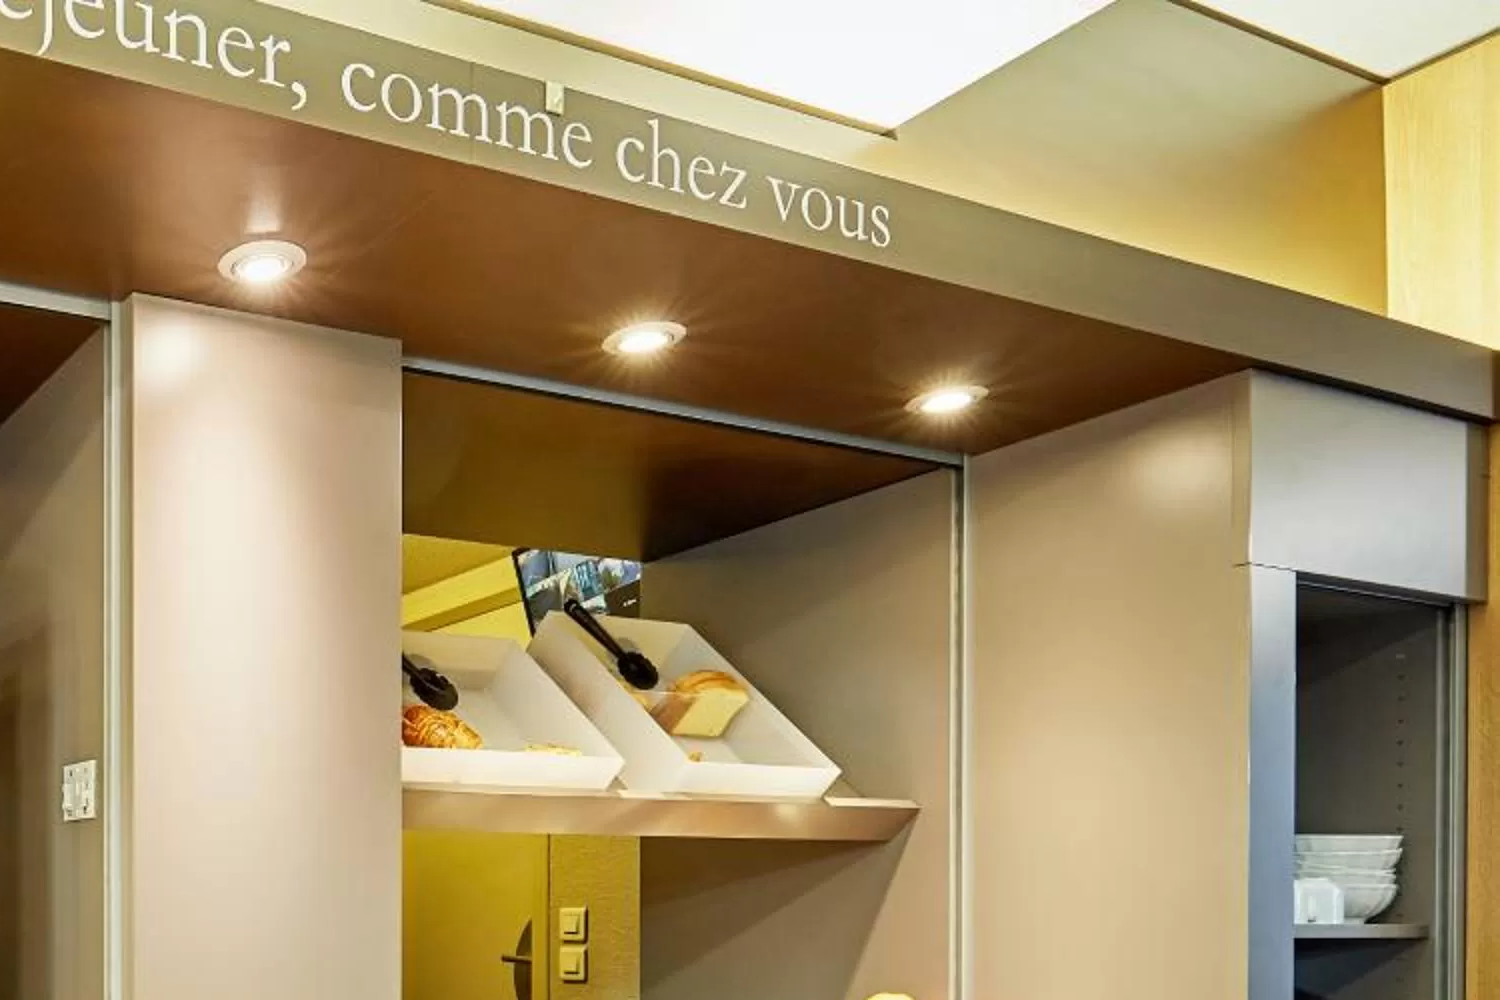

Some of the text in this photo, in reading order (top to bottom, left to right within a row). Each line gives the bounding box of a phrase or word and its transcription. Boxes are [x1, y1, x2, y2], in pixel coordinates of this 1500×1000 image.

[340, 61, 594, 169] comme
[615, 119, 748, 210] chez
[765, 175, 892, 248] vous
